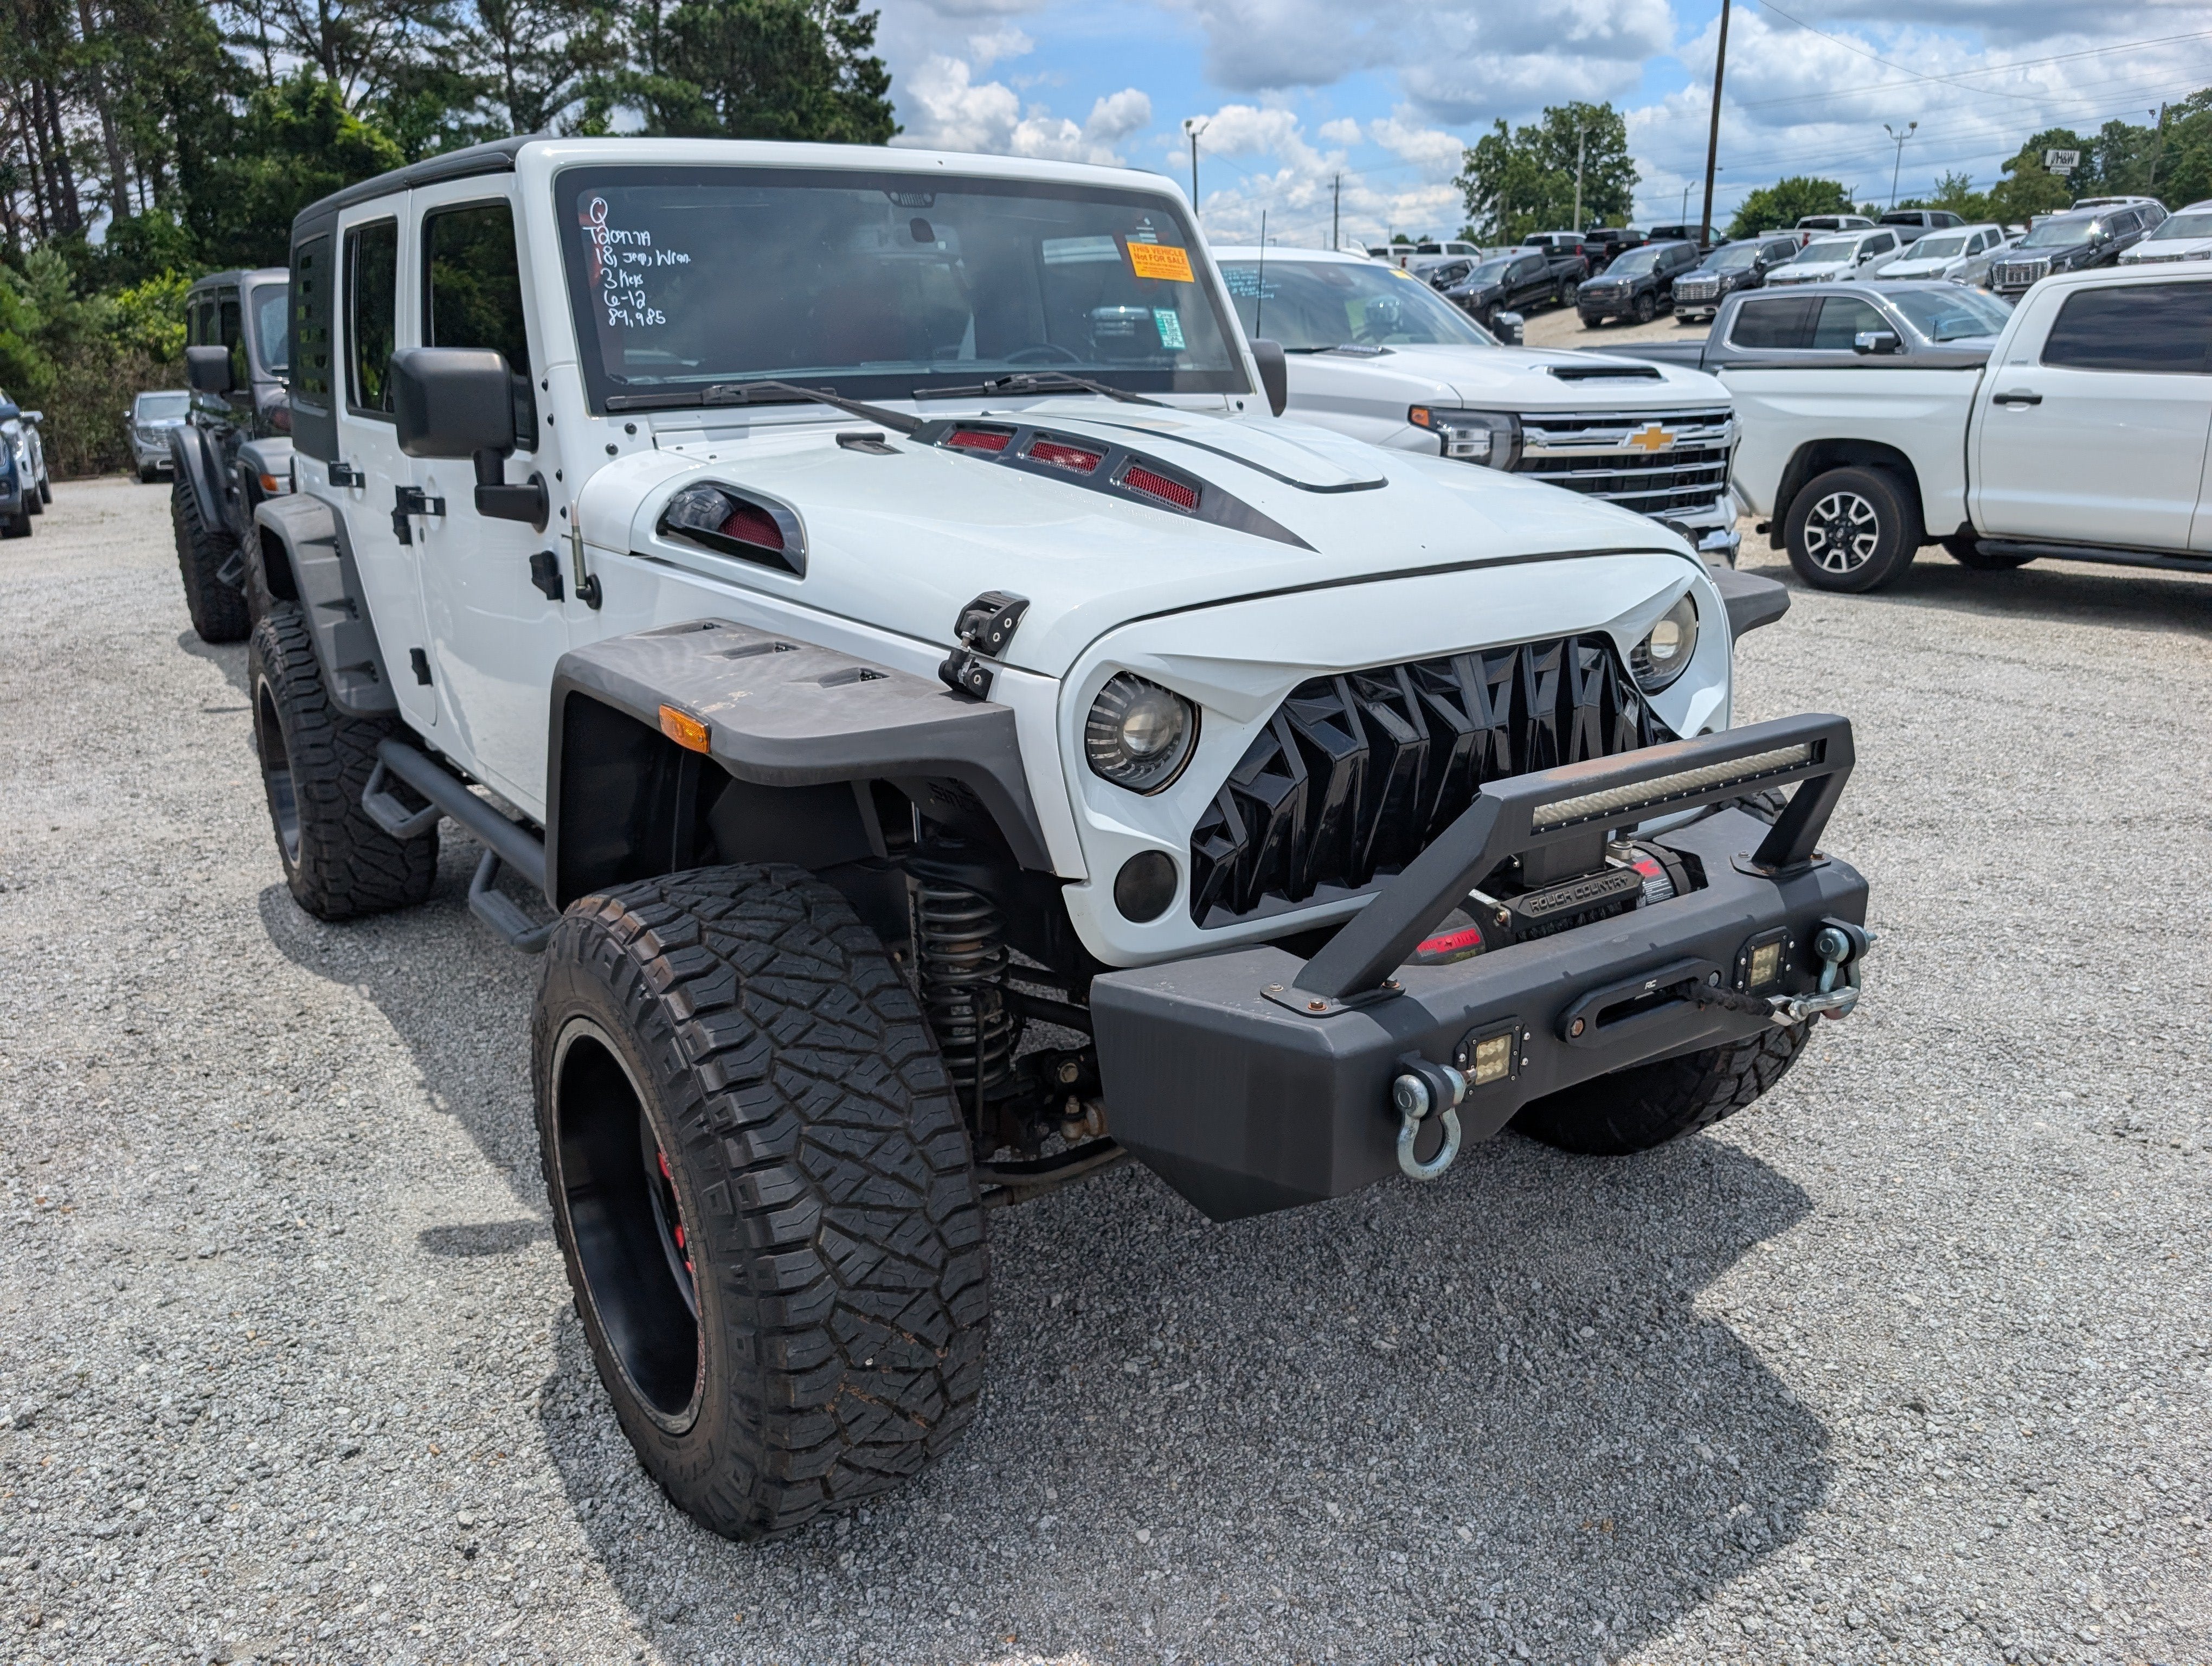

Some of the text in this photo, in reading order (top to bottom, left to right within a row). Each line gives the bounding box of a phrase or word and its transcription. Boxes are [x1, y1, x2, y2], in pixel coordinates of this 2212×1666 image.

[1132, 245, 1184, 257] THIS VEHICLE
[1149, 254, 1166, 262] FOR
[1167, 256, 1186, 265] SALE
[600, 267, 644, 289] 3 Keys
[604, 290, 646, 309] 6-12
[608, 308, 666, 328] 89,985
[1529, 890, 1572, 913] ROUGH
[1574, 875, 1628, 900] COUNTRY
[1644, 979, 1657, 990] RC
